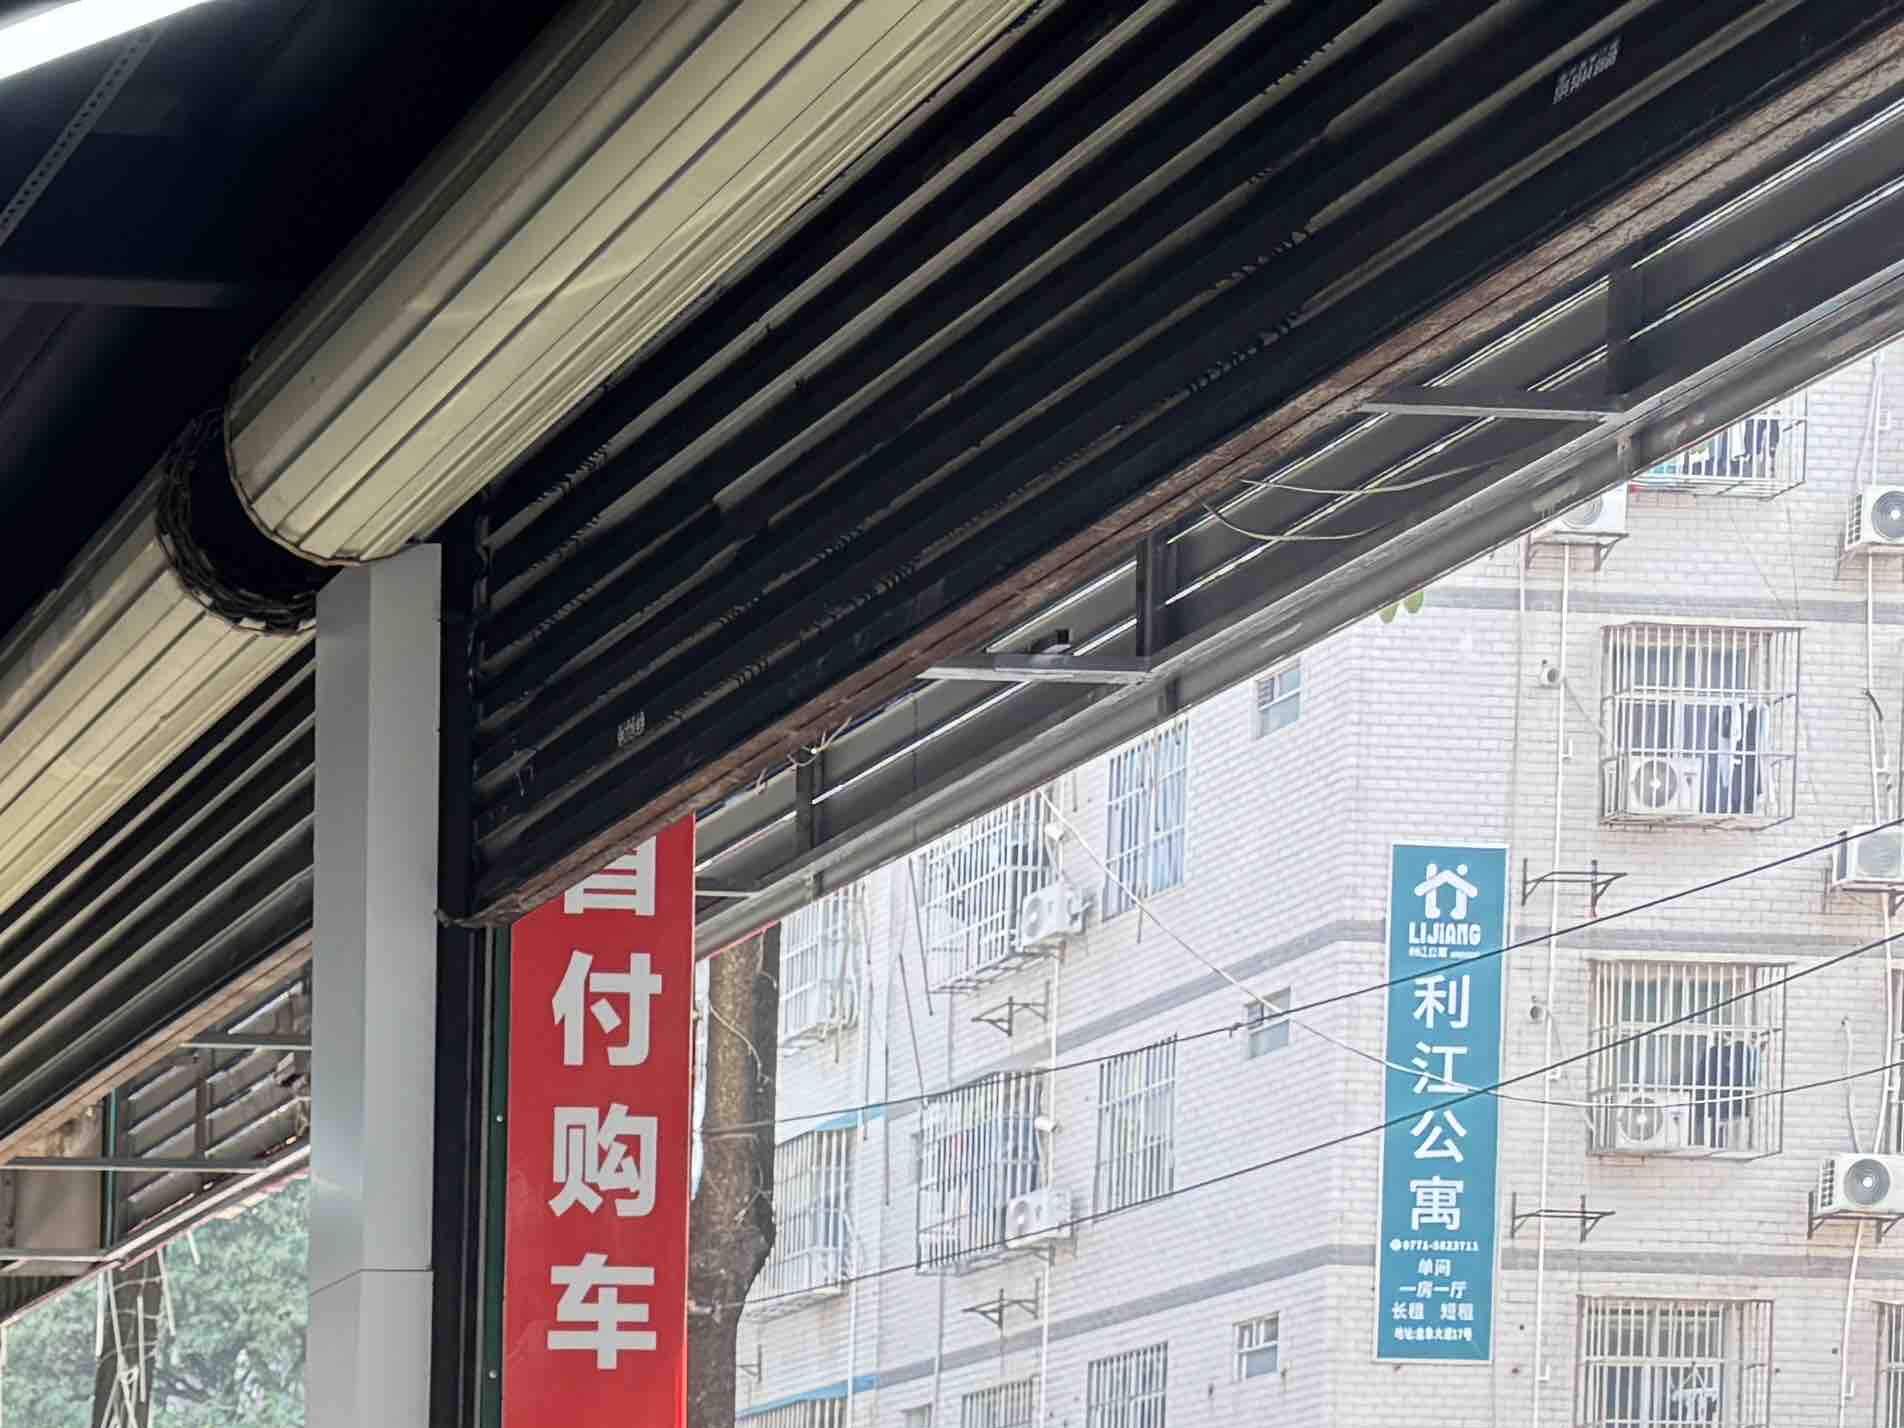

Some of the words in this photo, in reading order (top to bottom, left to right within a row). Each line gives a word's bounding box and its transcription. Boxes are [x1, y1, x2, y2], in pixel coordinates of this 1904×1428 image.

[1408, 922, 1481, 945] LIJIANG
[1410, 974, 1471, 1231] 利江公寓
[1399, 1281, 1467, 1299] 一房一厅
[1391, 1302, 1424, 1320] 长租
